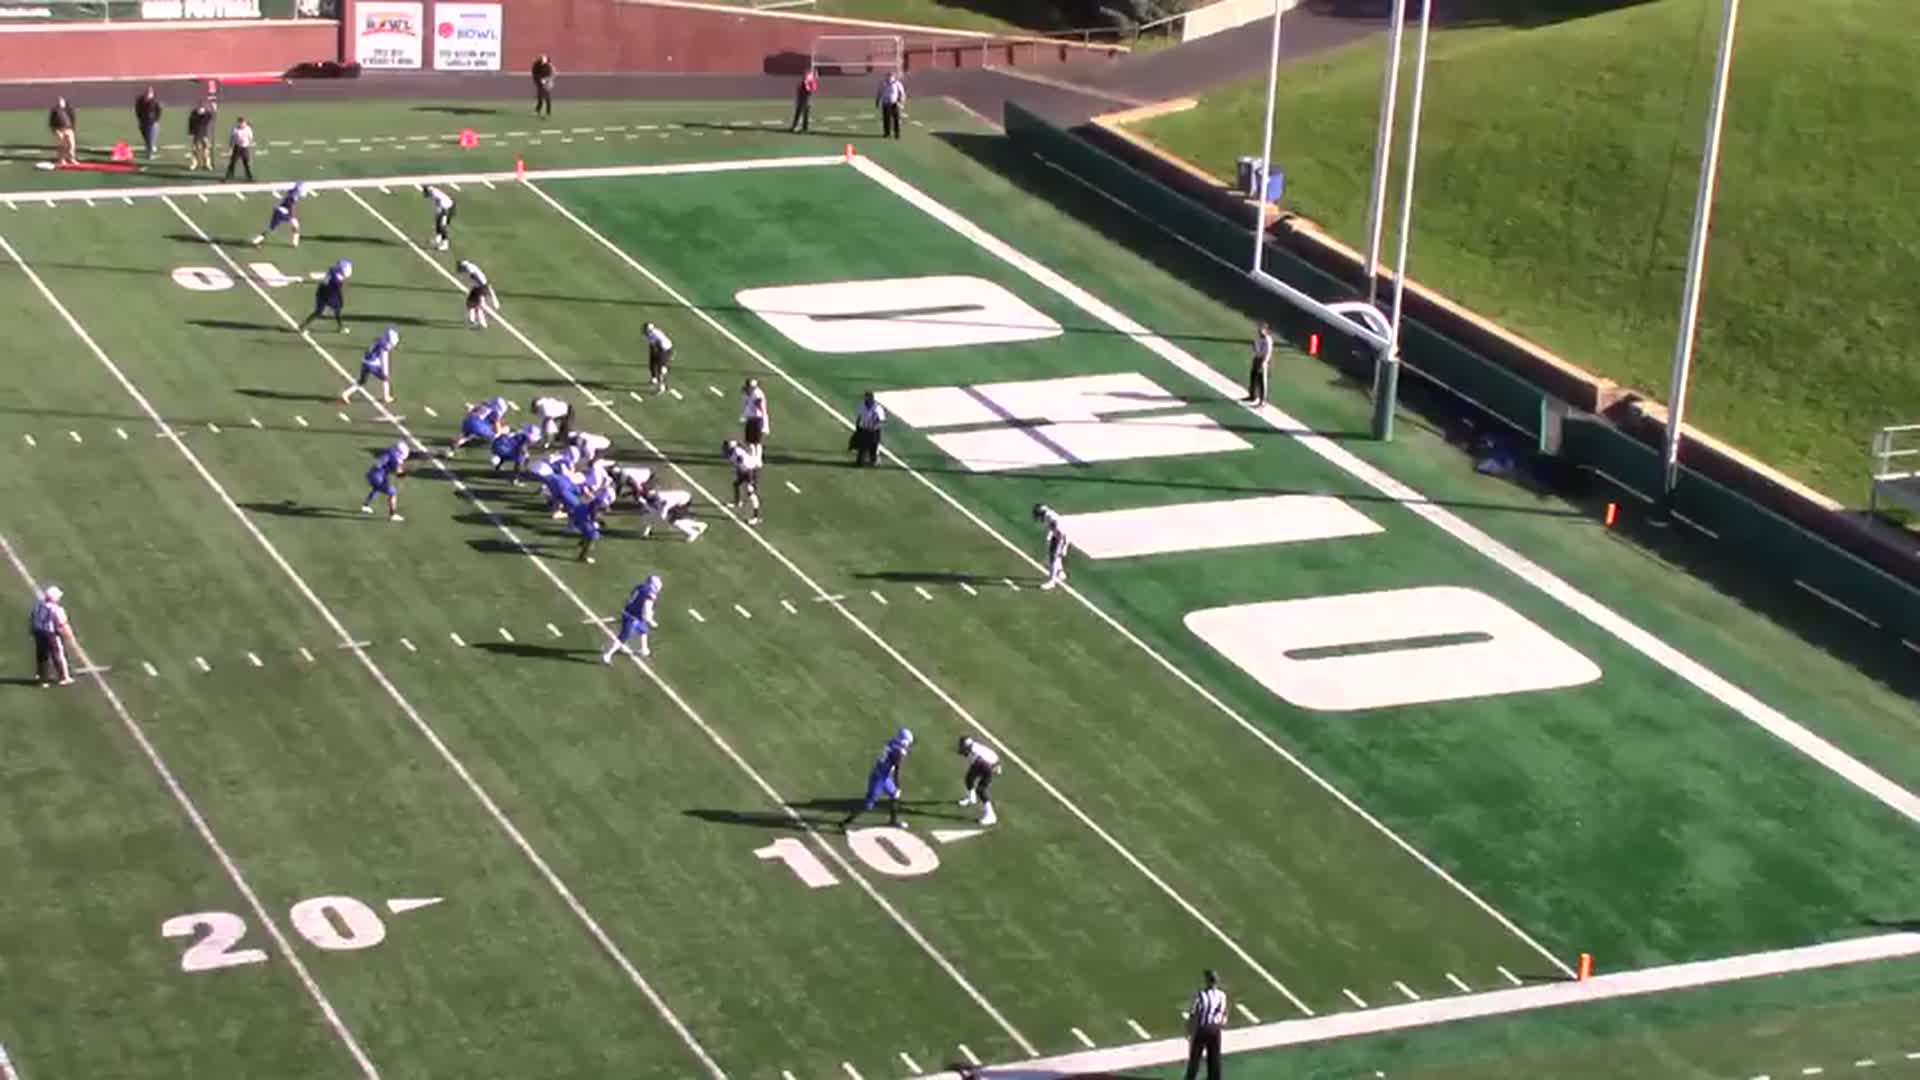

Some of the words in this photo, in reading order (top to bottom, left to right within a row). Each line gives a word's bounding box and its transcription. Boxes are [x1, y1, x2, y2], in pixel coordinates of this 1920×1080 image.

[735, 275, 1602, 711] OHIO
[753, 827, 940, 887] 10
[162, 896, 386, 972] 20
